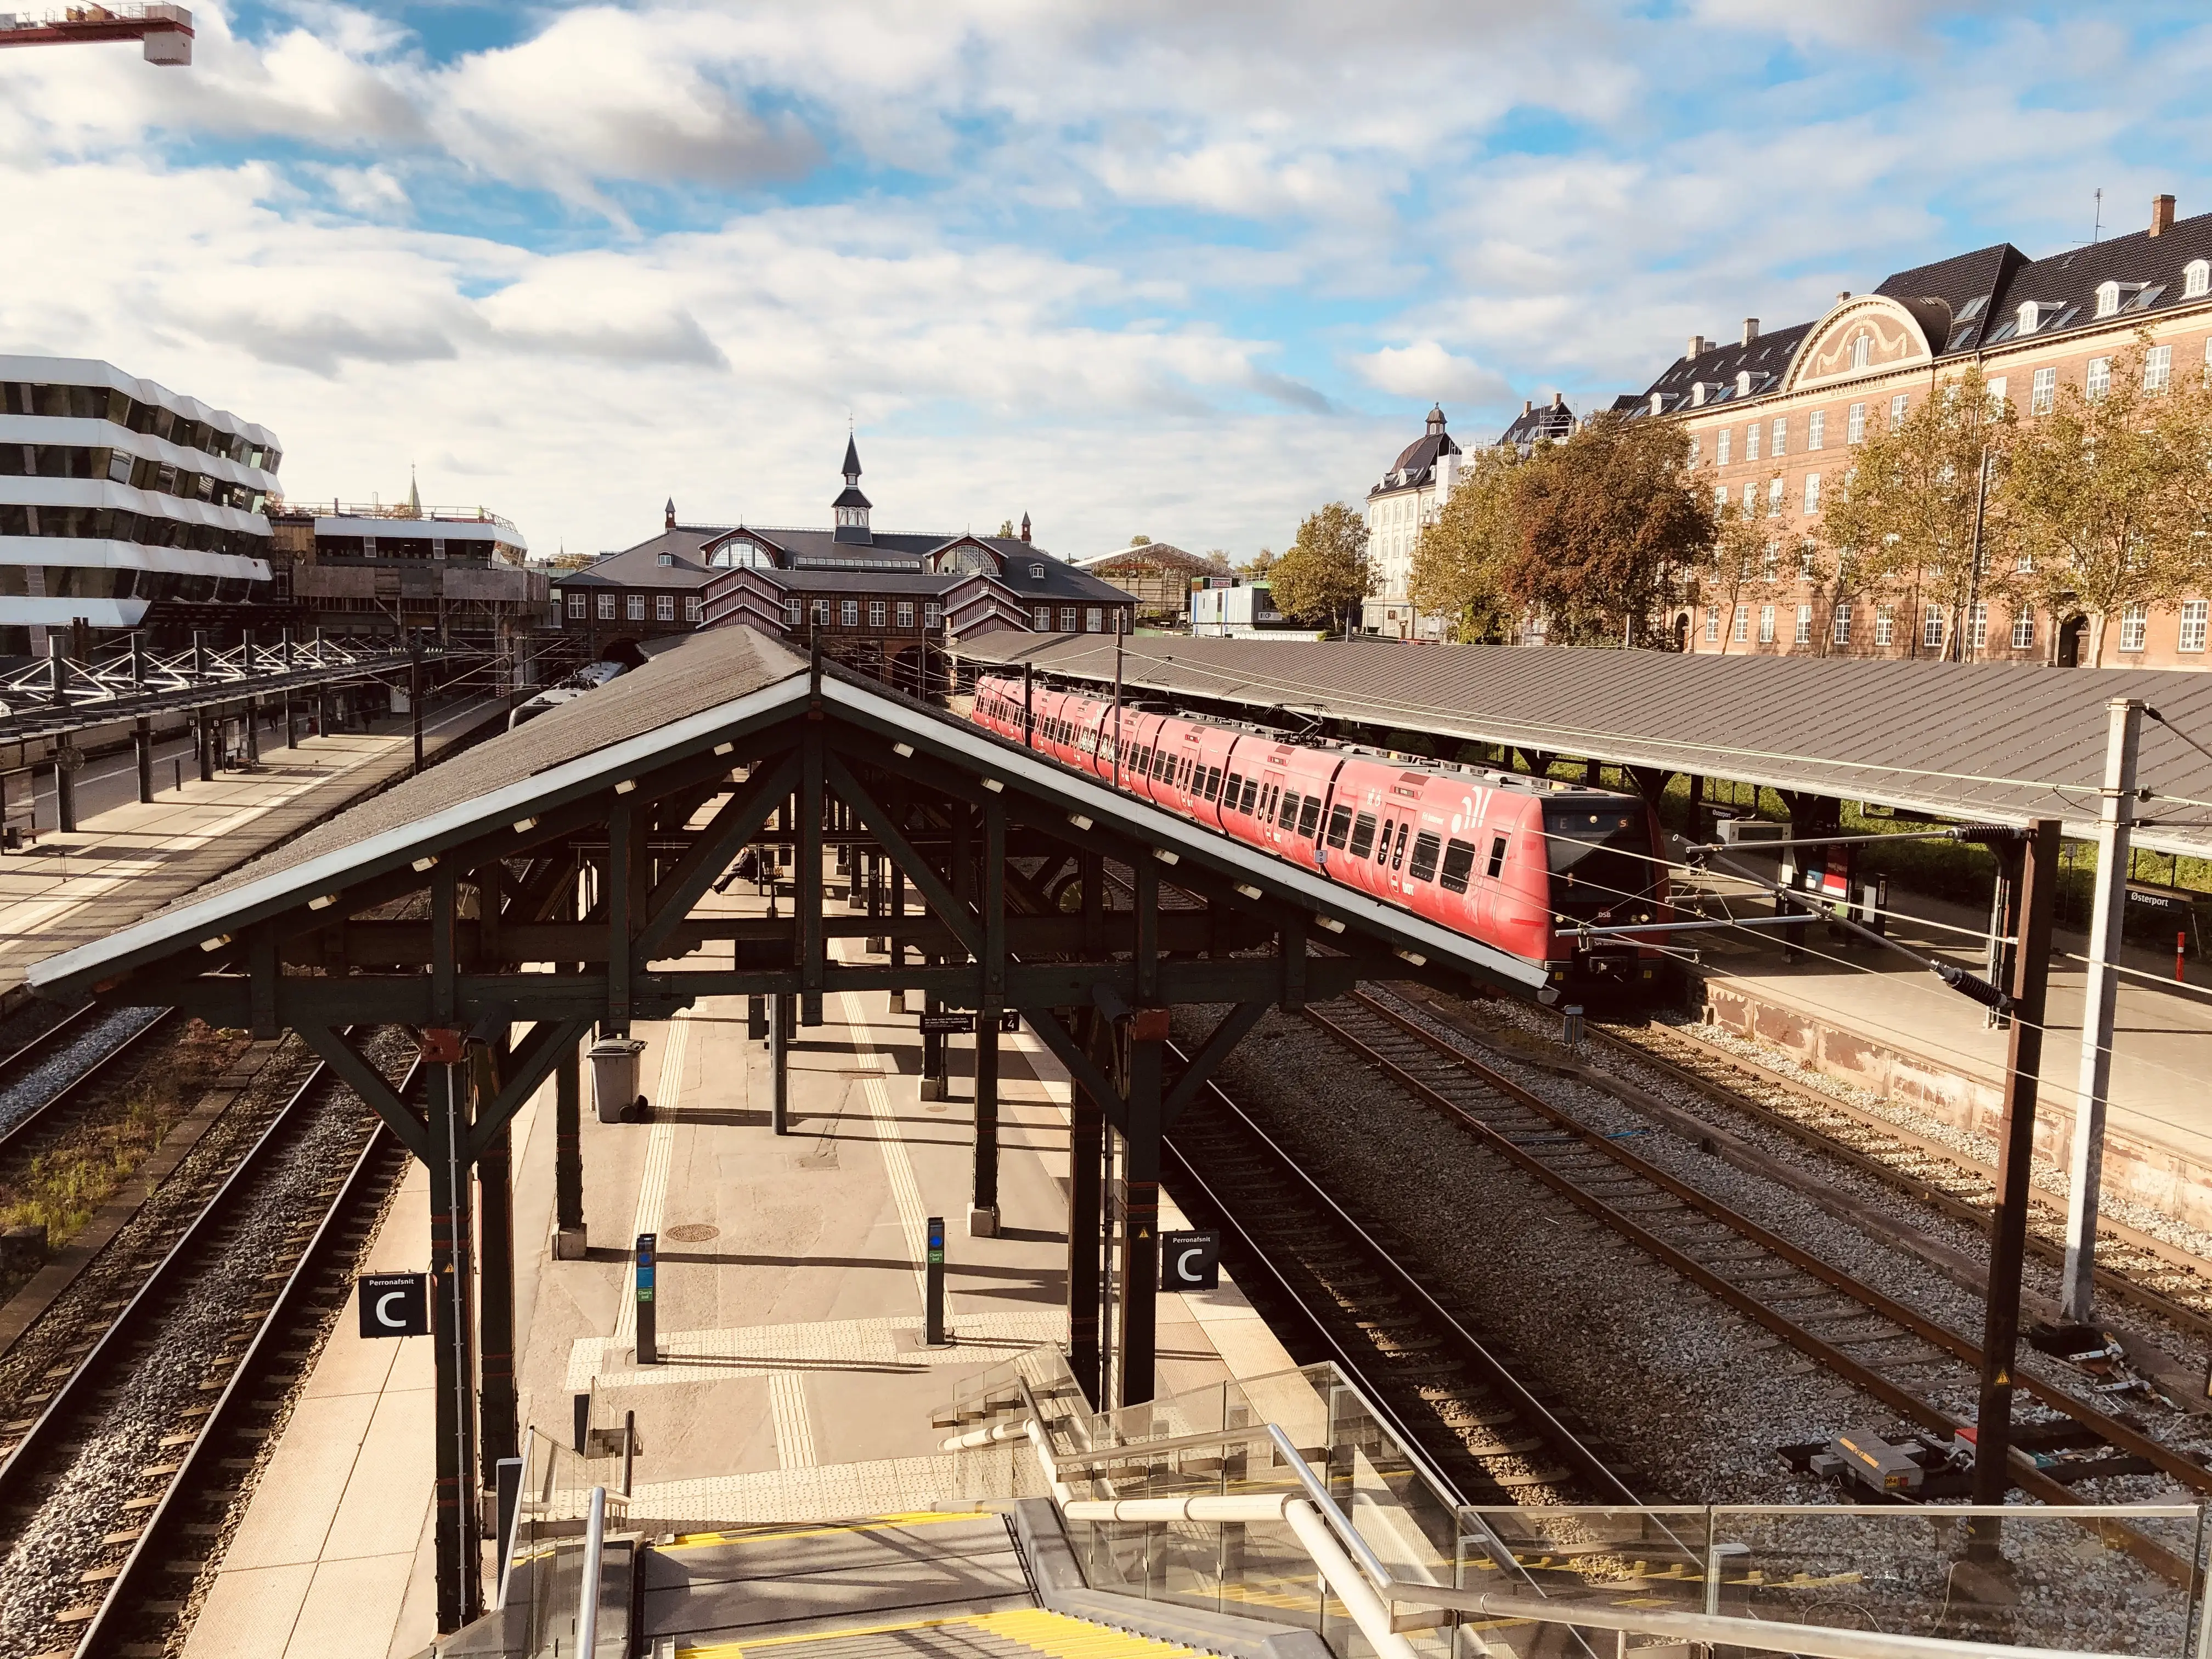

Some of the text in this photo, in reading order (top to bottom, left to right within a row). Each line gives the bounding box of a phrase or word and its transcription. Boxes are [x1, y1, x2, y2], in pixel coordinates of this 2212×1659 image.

[1560, 818, 1567, 829] E
[1619, 819, 1627, 827] S
[2131, 892, 2169, 907] Østerport
[1007, 1019, 1014, 1029] 4
[1177, 1249, 1203, 1282] C
[376, 1291, 407, 1327] C
